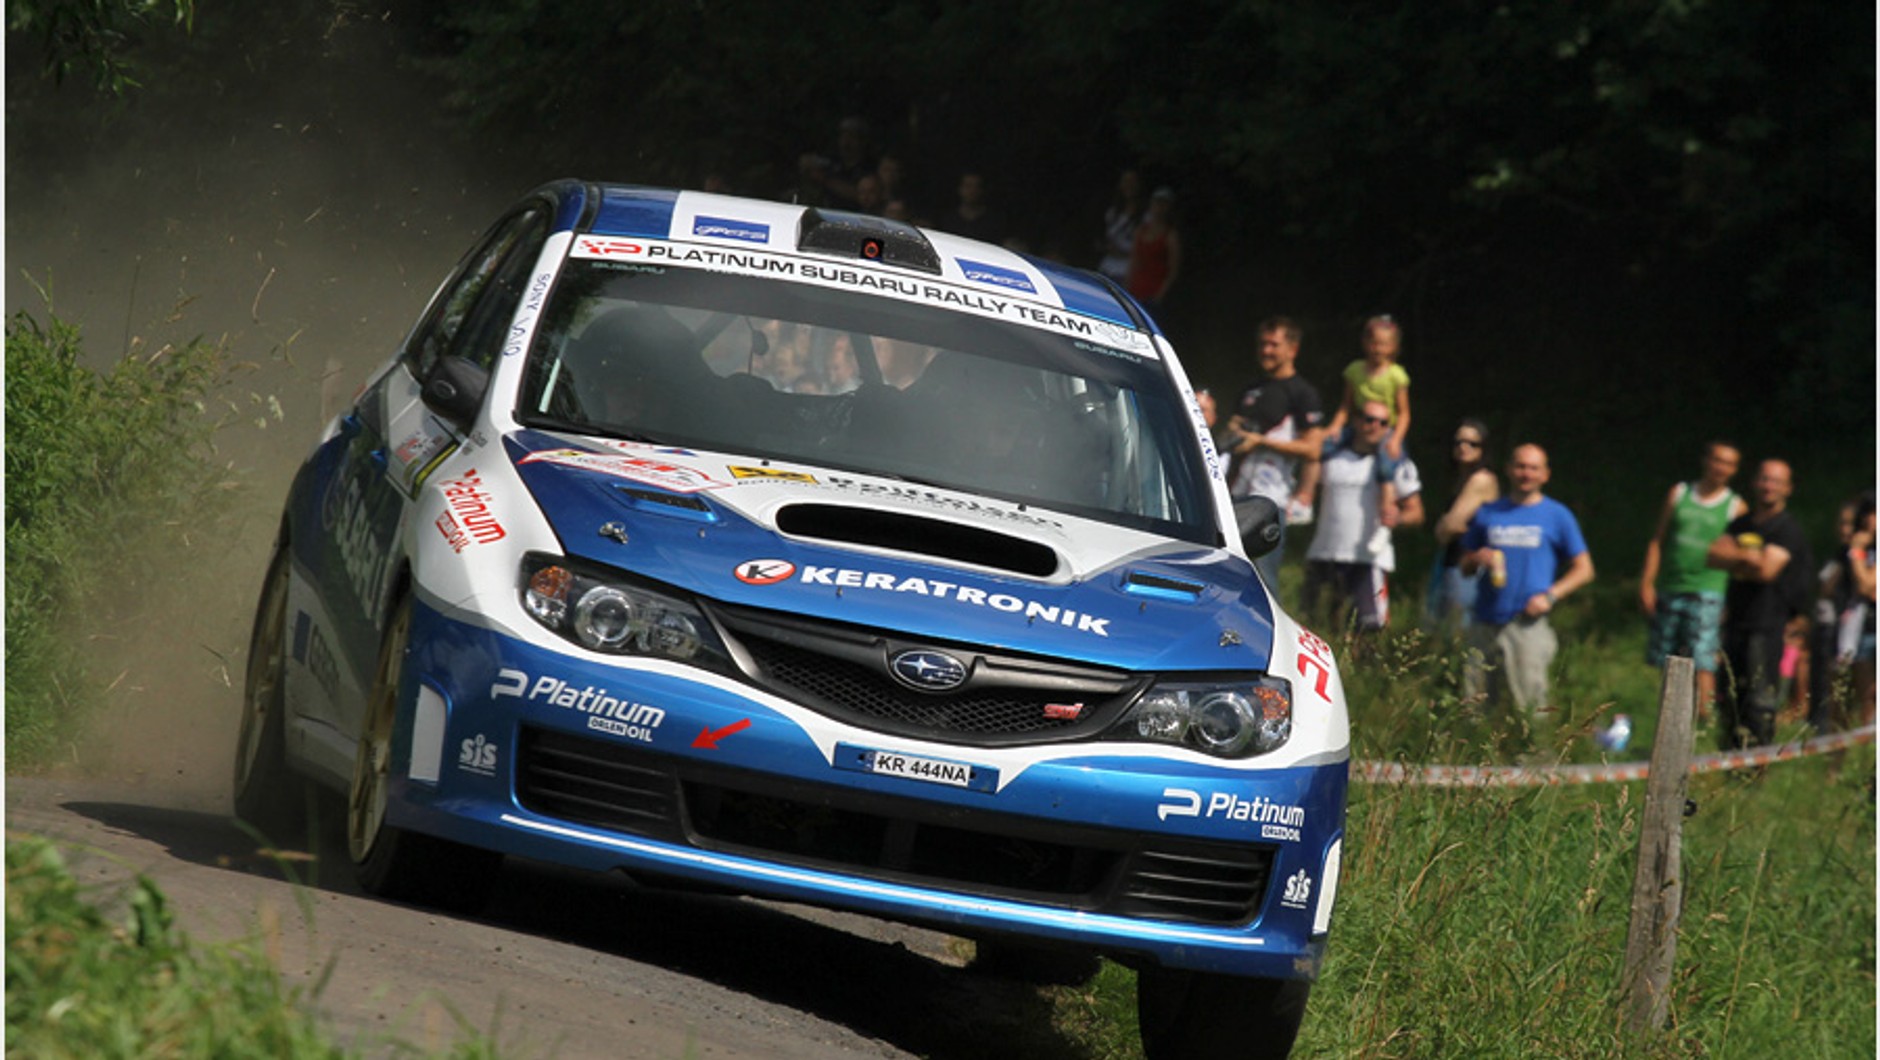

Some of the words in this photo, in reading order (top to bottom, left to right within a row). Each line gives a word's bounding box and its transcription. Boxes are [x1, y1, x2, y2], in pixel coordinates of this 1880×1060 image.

[648, 246, 794, 274] PLATINUM
[801, 264, 918, 296] SUBARU
[923, 287, 1008, 314] RALLY
[1013, 304, 1092, 335] TEAM
[801, 565, 1112, 638] KERATRONIK
[529, 676, 666, 728] Platinum
[627, 726, 653, 742] OIL
[876, 755, 905, 774] KR
[910, 761, 967, 783] 444NA
[1206, 792, 1305, 828] Platinum
